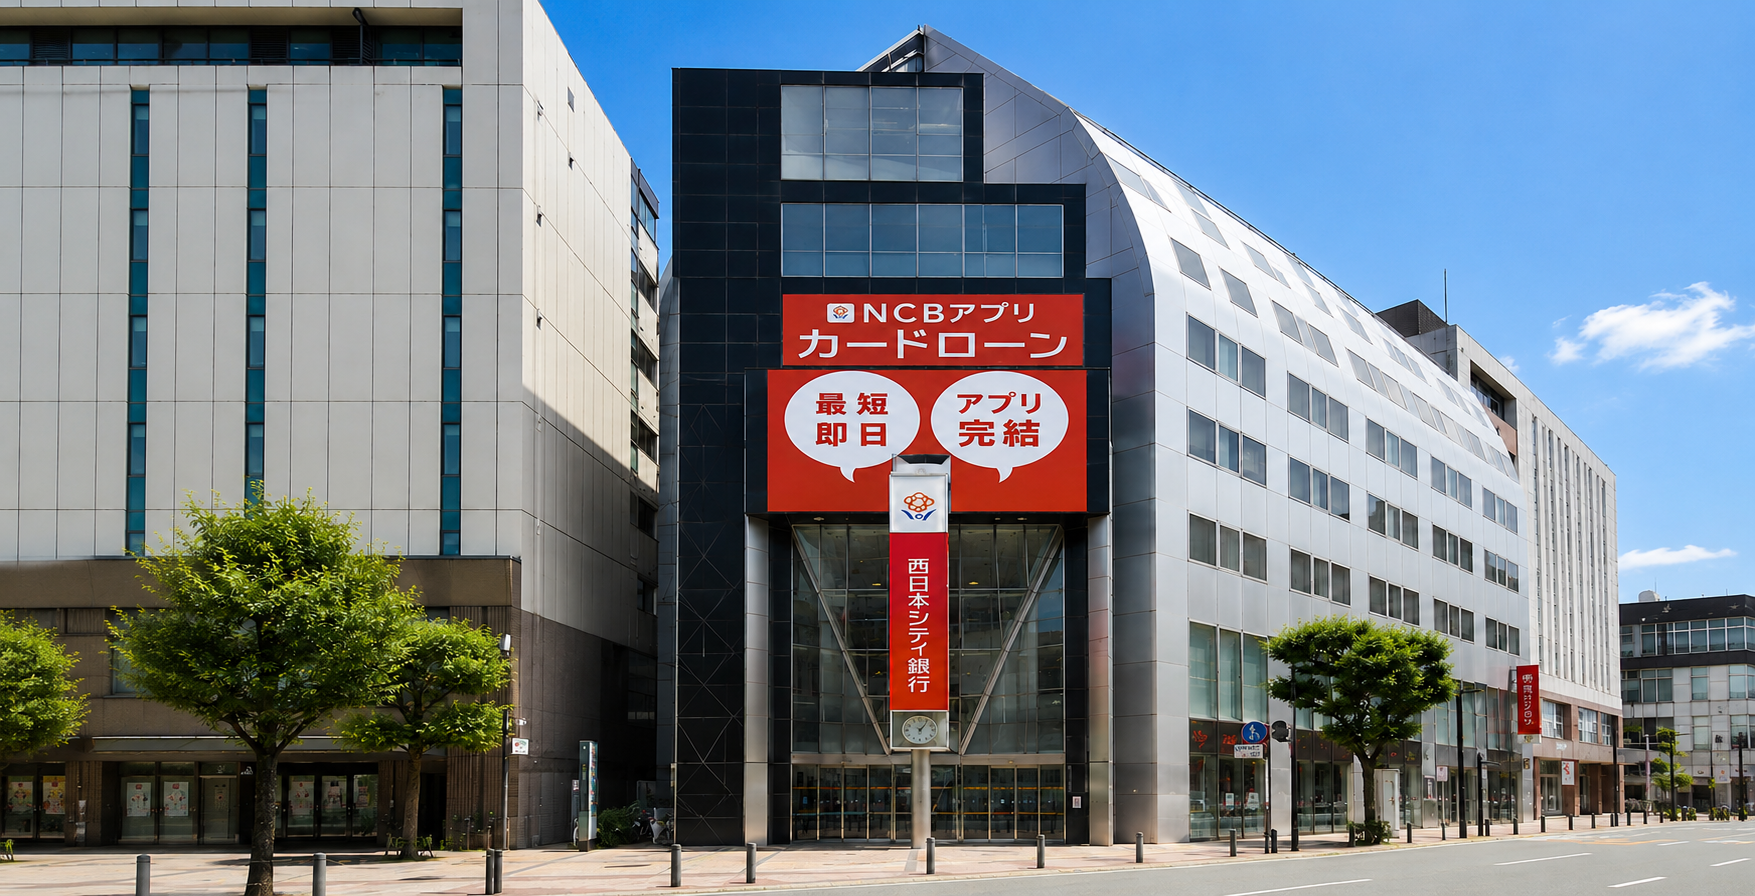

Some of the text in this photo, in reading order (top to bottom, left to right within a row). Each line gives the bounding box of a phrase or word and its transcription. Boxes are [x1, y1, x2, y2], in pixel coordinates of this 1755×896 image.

[863, 301, 1035, 323] NCBアプリ
[798, 328, 1068, 359] カードローン
[815, 392, 889, 416] 最短
[957, 391, 1041, 414] アプリ
[815, 422, 887, 447] 即日
[958, 419, 1041, 448] 完結
[907, 558, 930, 693] 西日本シティ銀行
